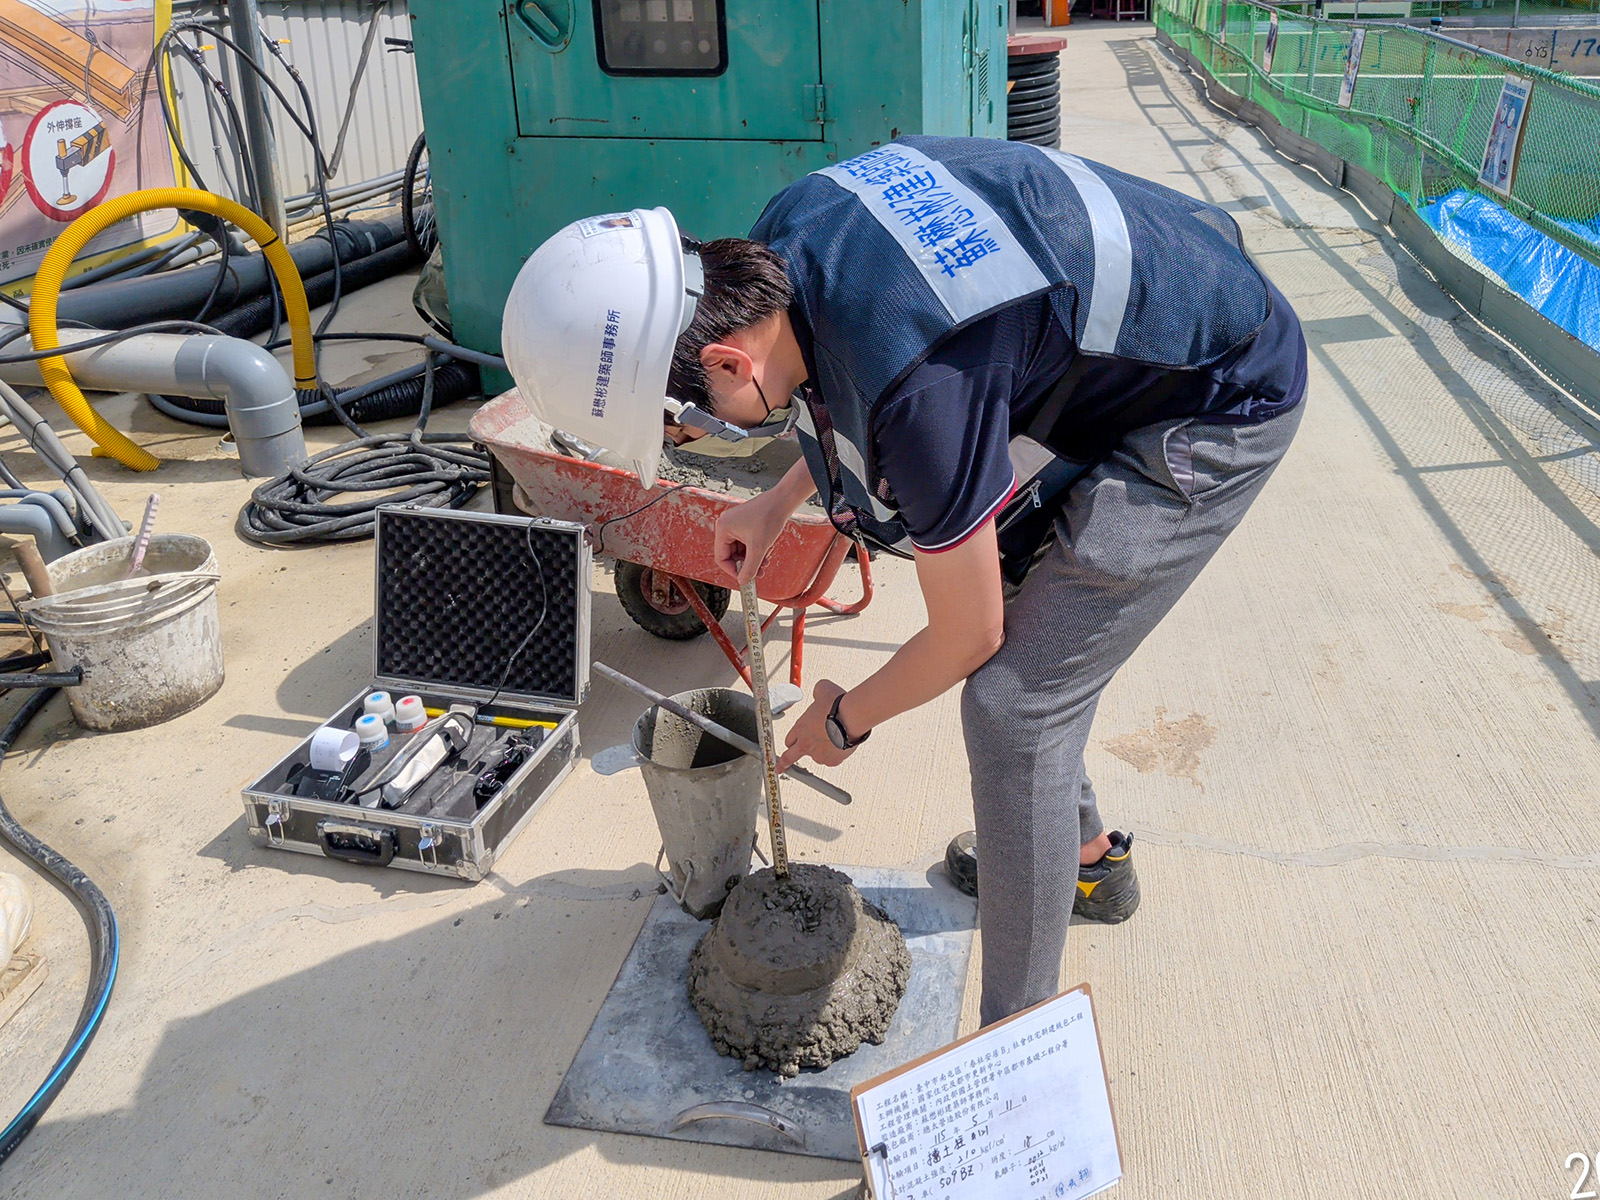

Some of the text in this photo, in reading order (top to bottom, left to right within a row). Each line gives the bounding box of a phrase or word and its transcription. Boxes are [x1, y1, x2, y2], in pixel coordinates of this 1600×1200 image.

[591, 308, 621, 419] 蘇懋彬建築師事務所
